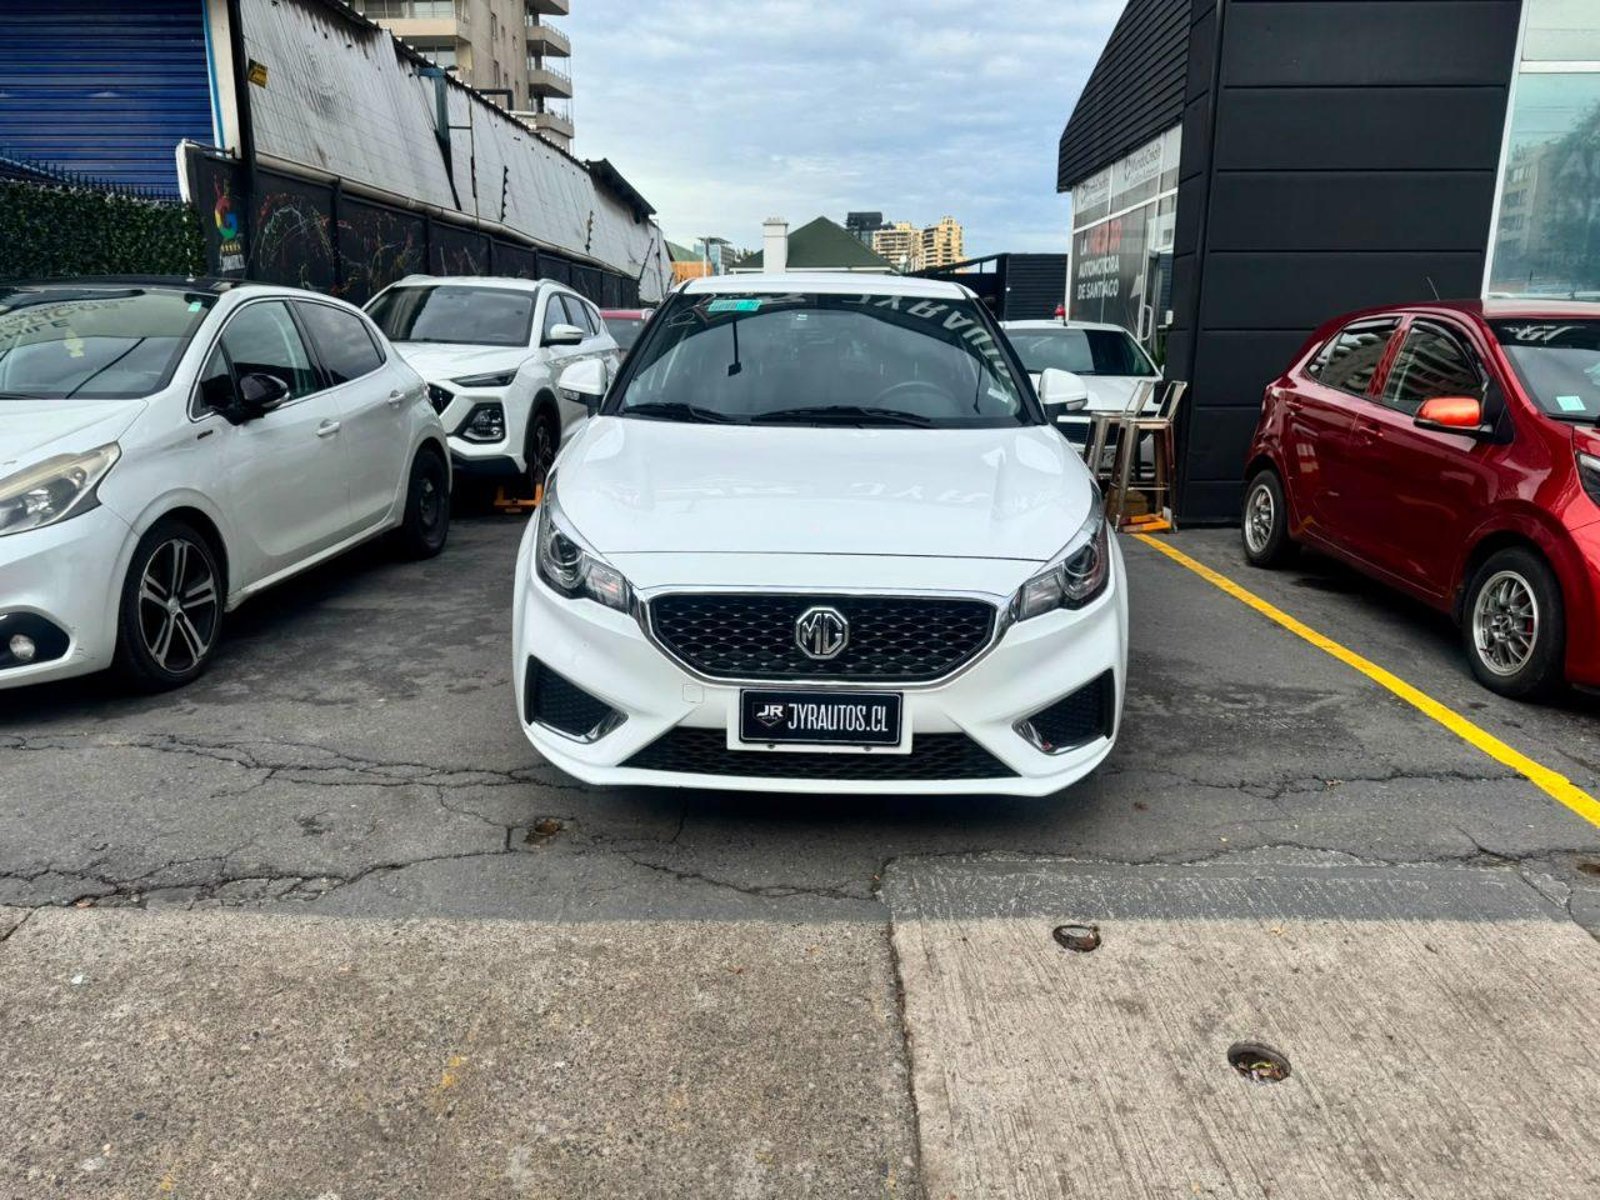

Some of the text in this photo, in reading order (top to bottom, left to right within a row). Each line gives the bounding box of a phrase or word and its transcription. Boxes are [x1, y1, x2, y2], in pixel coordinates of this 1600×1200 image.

[1077, 278, 1119, 300] DE SANTIAGO
[801, 612, 843, 655] MG
[756, 703, 889, 731] JR JYRAUTOS.CL
